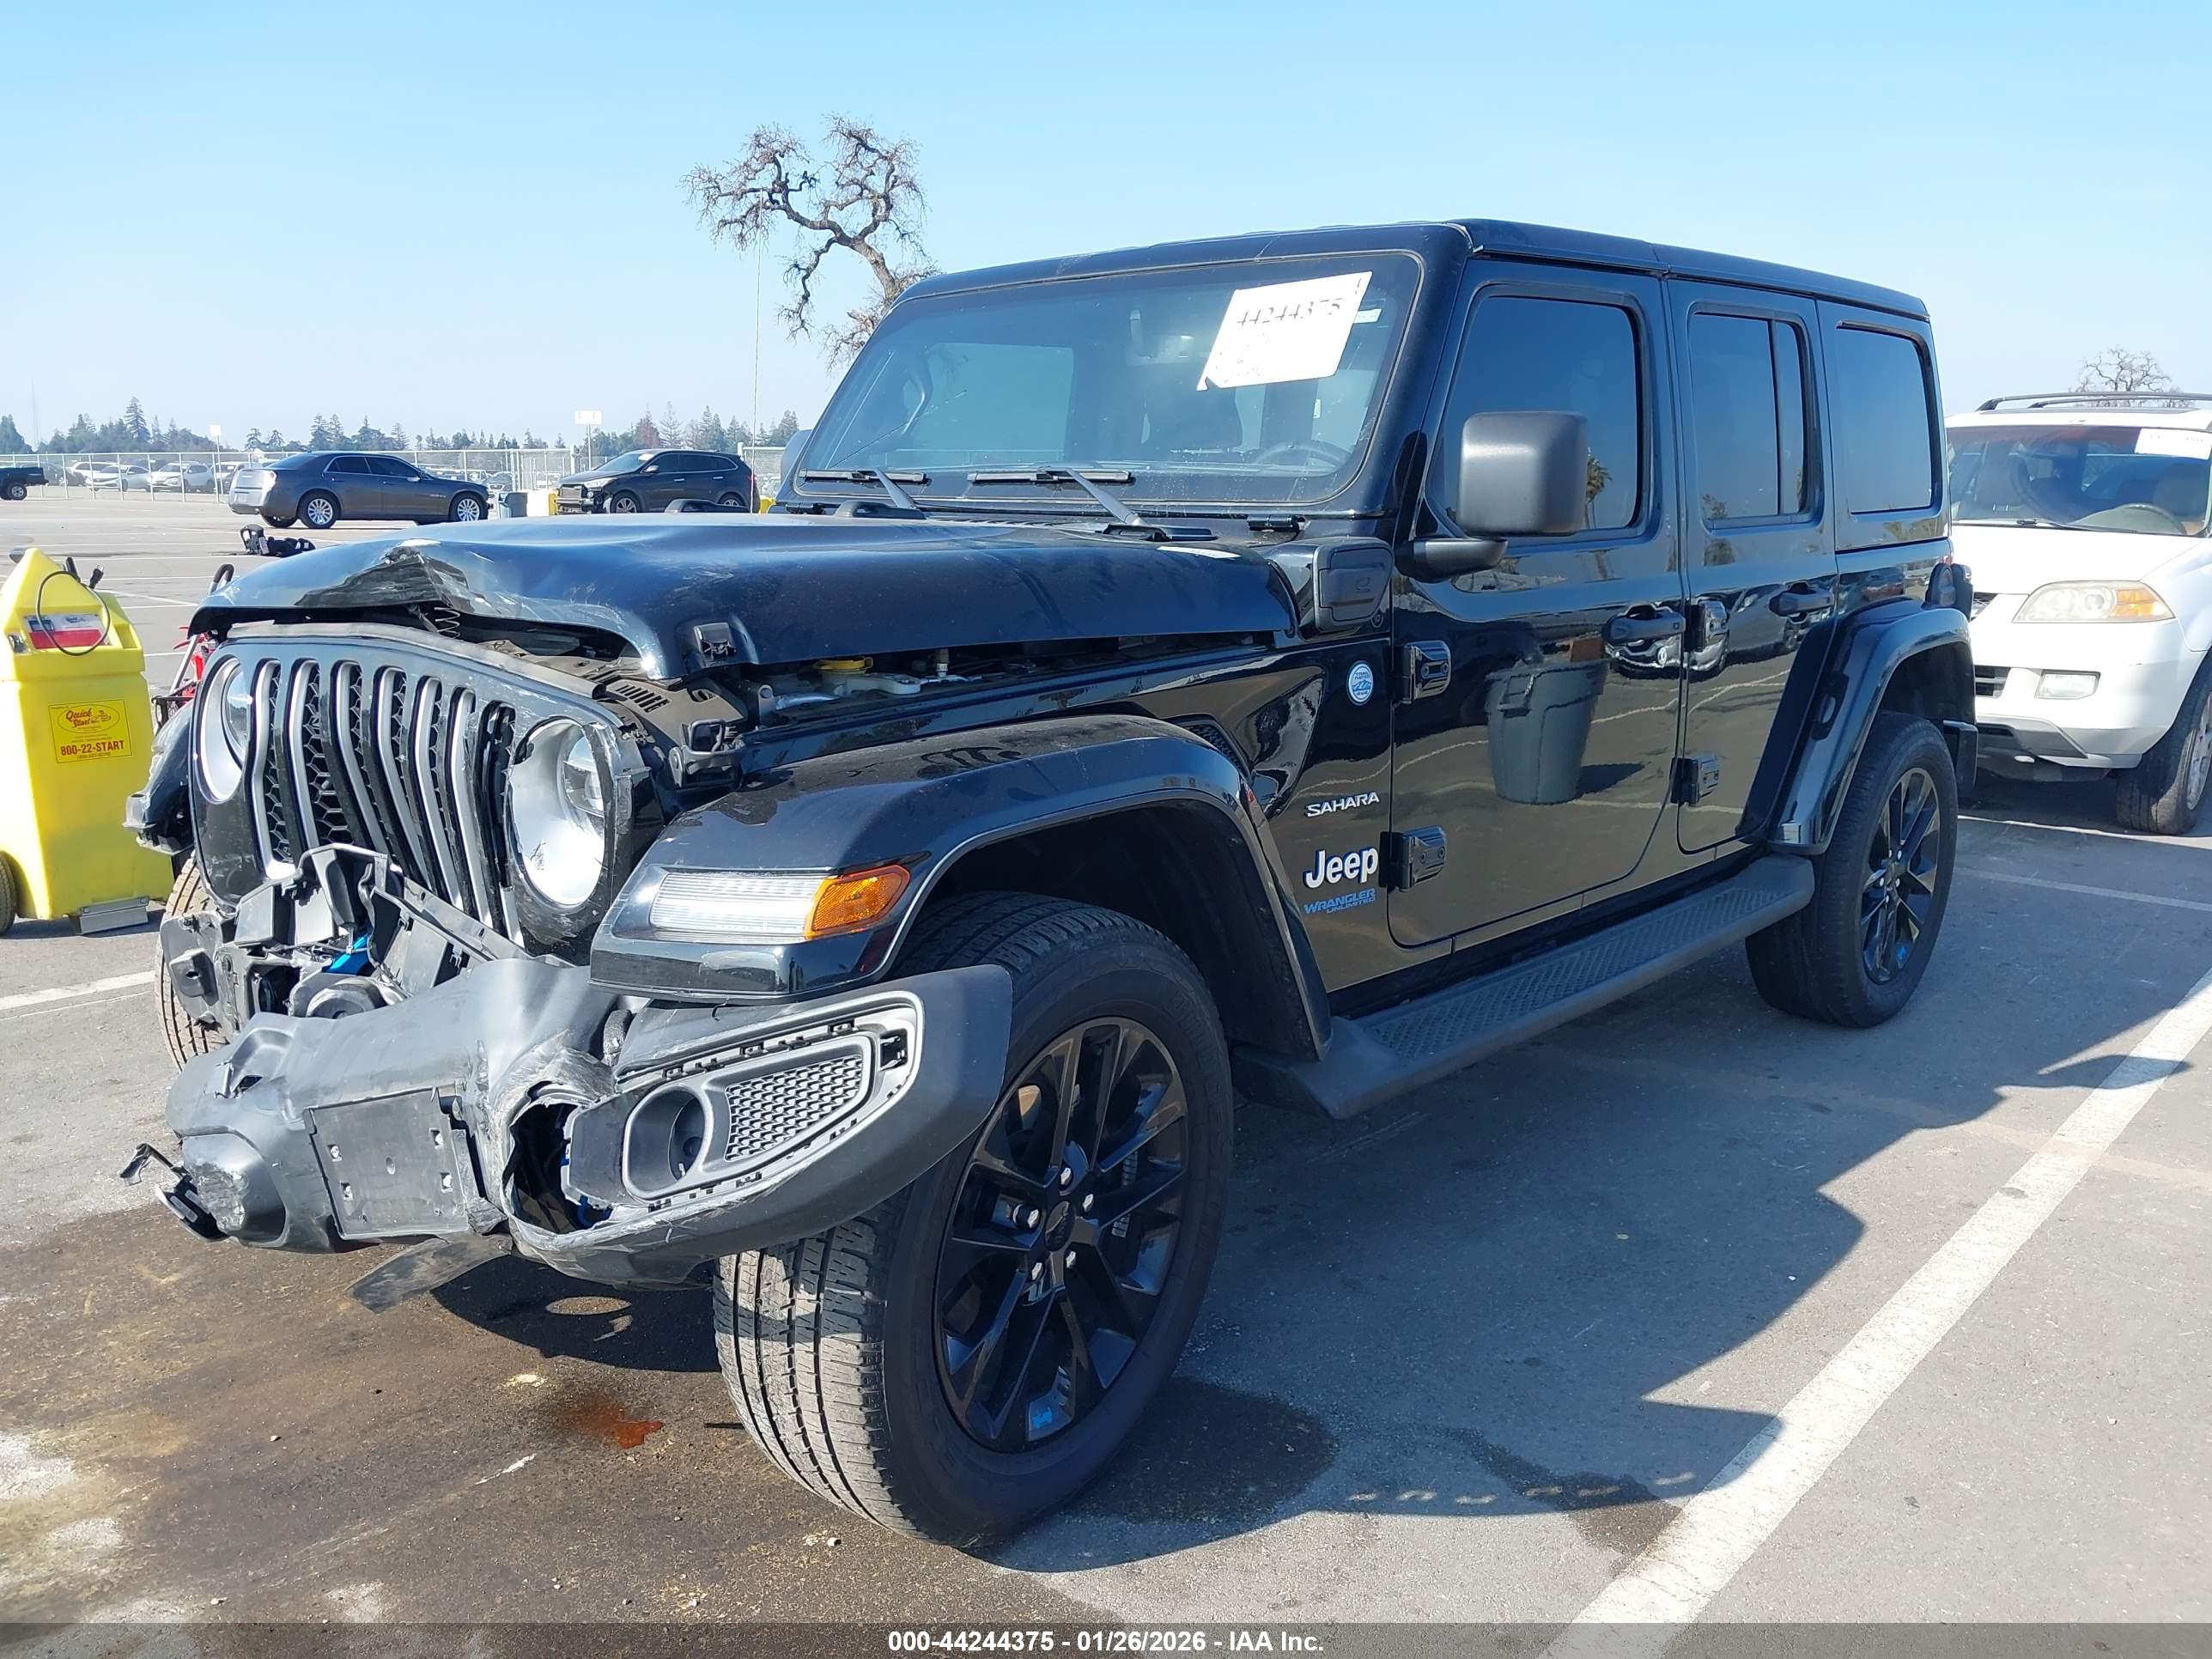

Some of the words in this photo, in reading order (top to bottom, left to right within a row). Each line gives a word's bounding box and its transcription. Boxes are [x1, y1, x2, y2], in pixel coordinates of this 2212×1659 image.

[65, 708, 92, 722] Quick
[72, 719, 90, 728] Start
[60, 740, 125, 756] 800-22-START
[1304, 792, 1381, 817] SAHARA
[1304, 848, 1379, 888] Jeep
[1304, 888, 1376, 914] WRANGLER
[1326, 897, 1376, 914] UNLIMITED
